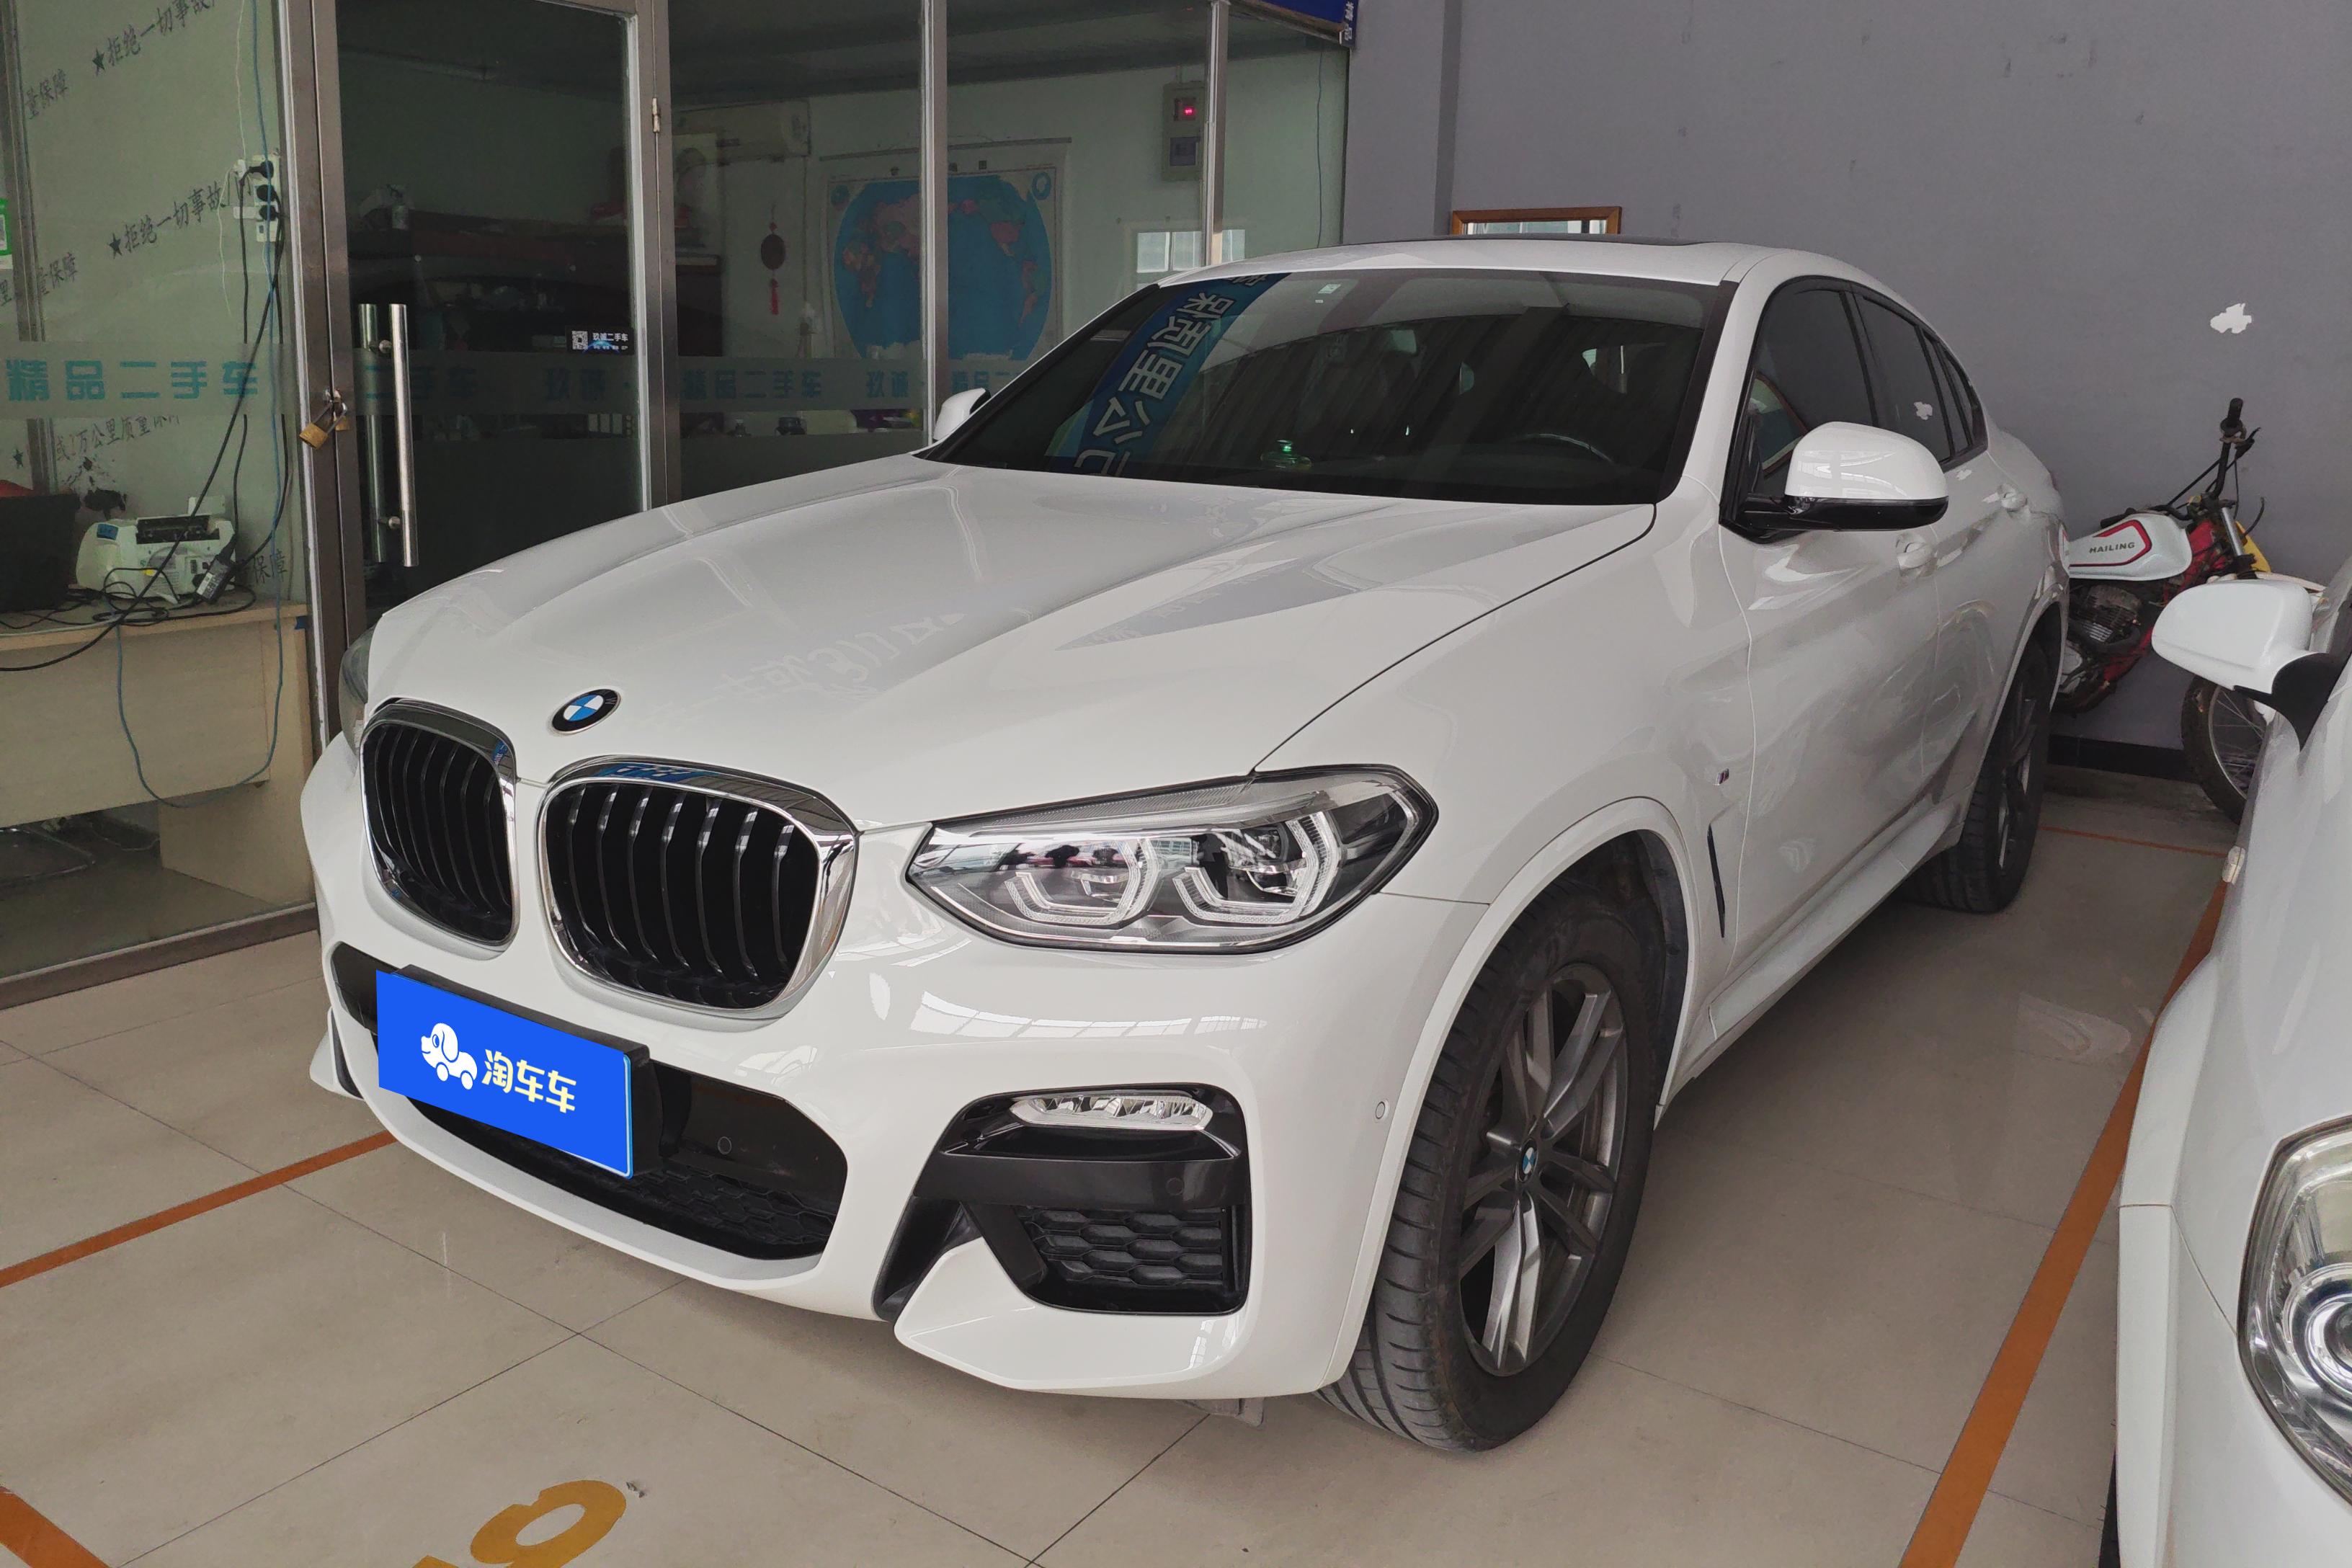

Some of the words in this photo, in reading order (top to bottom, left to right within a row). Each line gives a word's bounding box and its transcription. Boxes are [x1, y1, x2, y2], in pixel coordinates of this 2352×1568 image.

[124, 180, 226, 253] 拒绝一切事故
[592, 332, 629, 342] 玖诚二手车
[6, 360, 259, 401] 精品二手车
[681, 370, 822, 400] 精品二手车
[2089, 542, 2135, 554] HAILING
